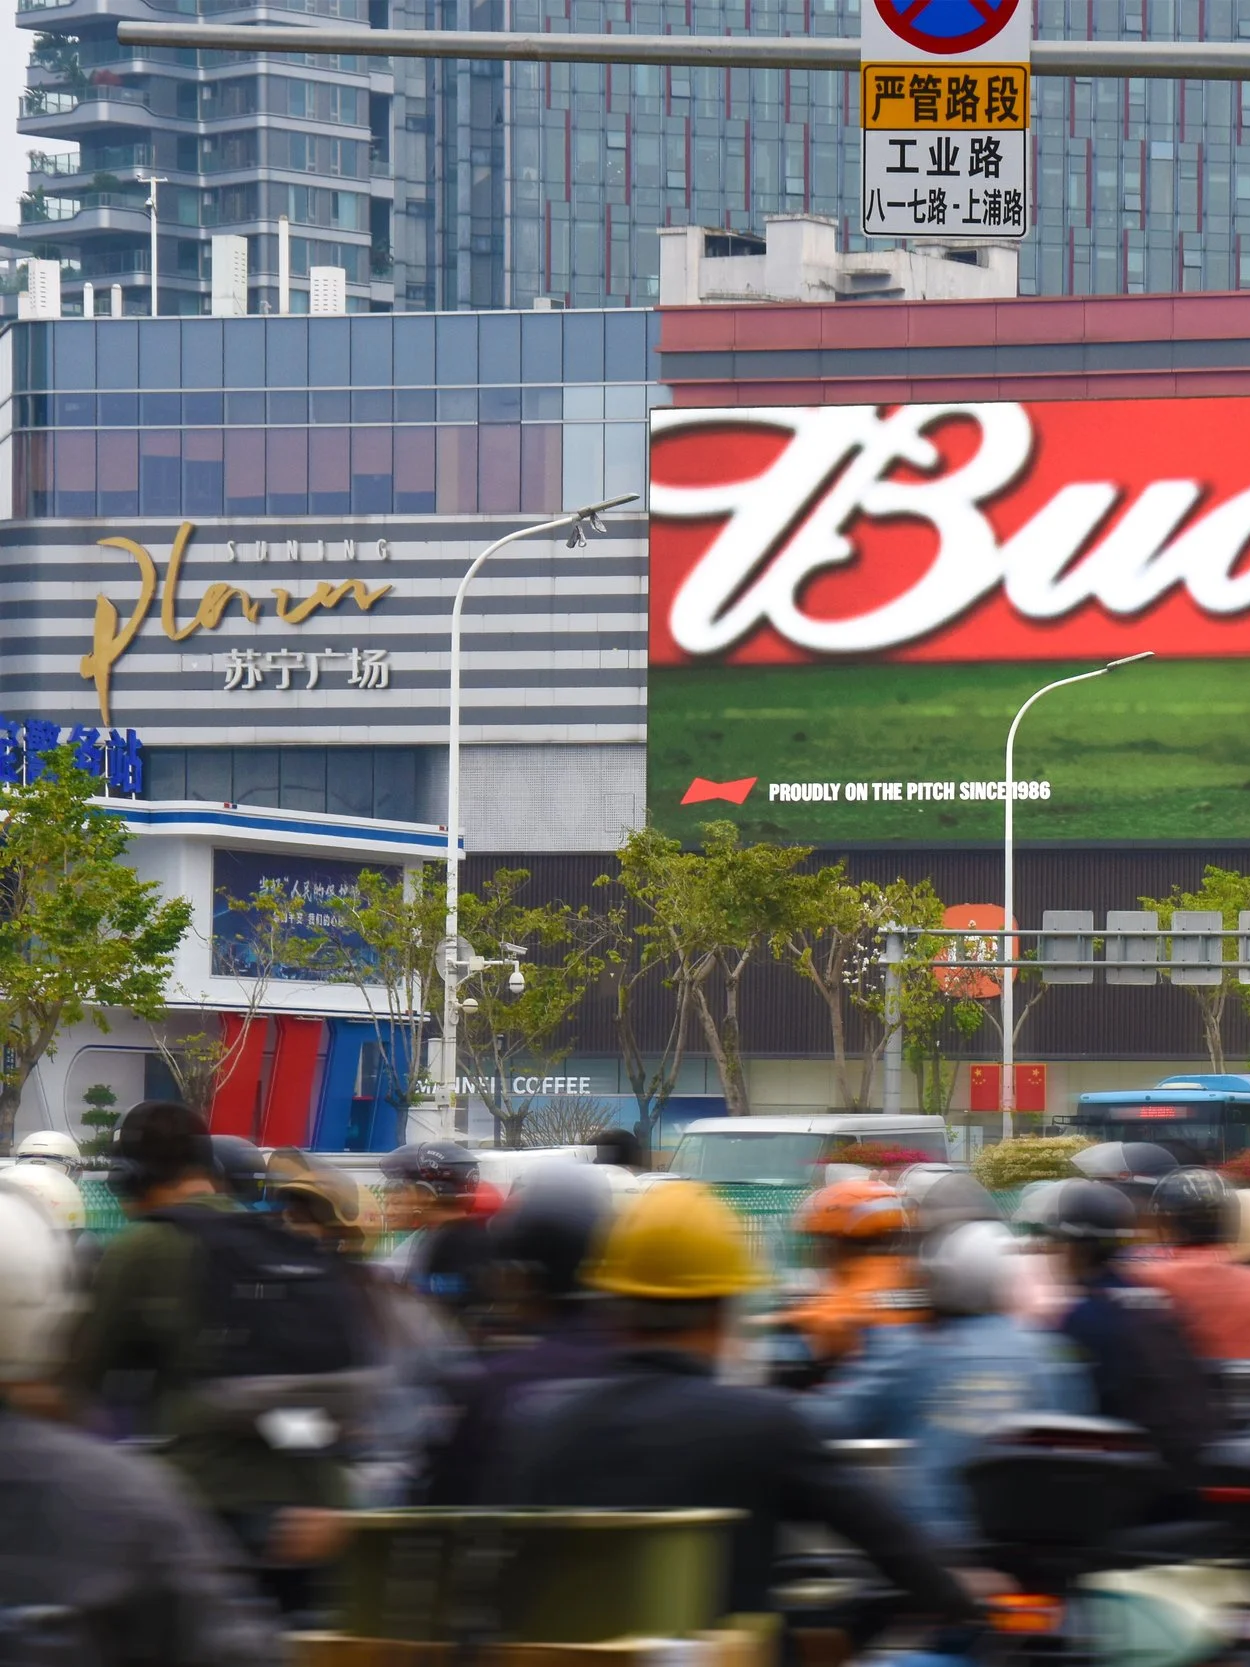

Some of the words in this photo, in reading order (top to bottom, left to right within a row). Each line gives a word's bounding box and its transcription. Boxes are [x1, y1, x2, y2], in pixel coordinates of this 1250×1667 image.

[871, 74, 1019, 123] 严管路段
[886, 136, 1003, 178] 工业路
[227, 539, 388, 562] SUNING
[224, 648, 389, 690] 苏宁广场
[769, 783, 841, 801] PROUDLY
[845, 782, 868, 800] ON
[872, 782, 903, 800] THE
[906, 782, 955, 800] PITCH
[959, 781, 1007, 800] SINCE
[1011, 780, 1051, 800] 1986
[513, 1076, 591, 1095] COFFEE
